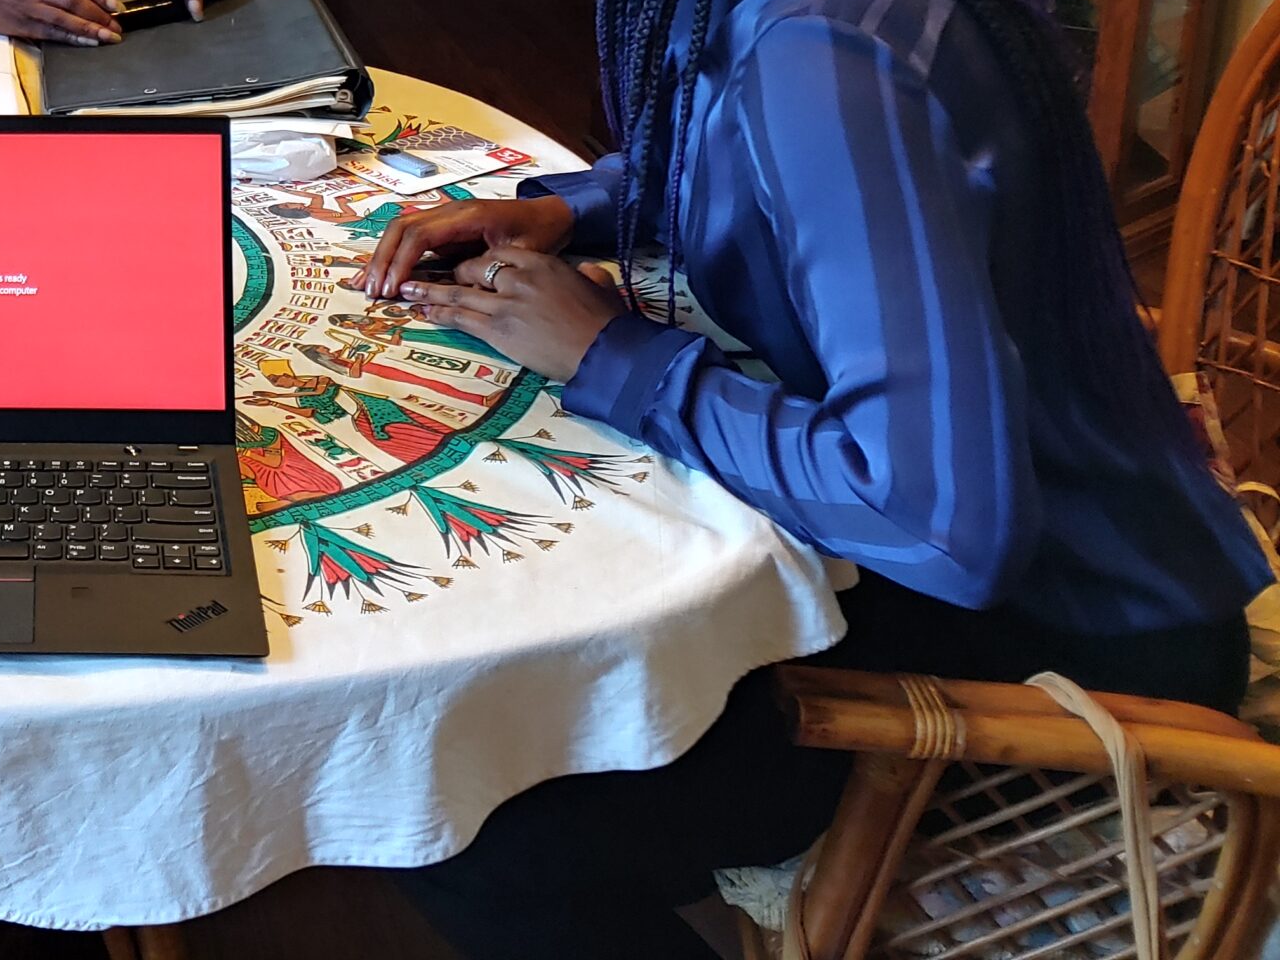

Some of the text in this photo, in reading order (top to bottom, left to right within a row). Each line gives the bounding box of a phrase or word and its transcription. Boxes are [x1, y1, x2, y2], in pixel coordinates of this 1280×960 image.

[345, 160, 404, 187] SanDisk
[4, 274, 27, 284] ready
[0, 287, 37, 296] computer
[165, 600, 228, 632] ThinkPad
